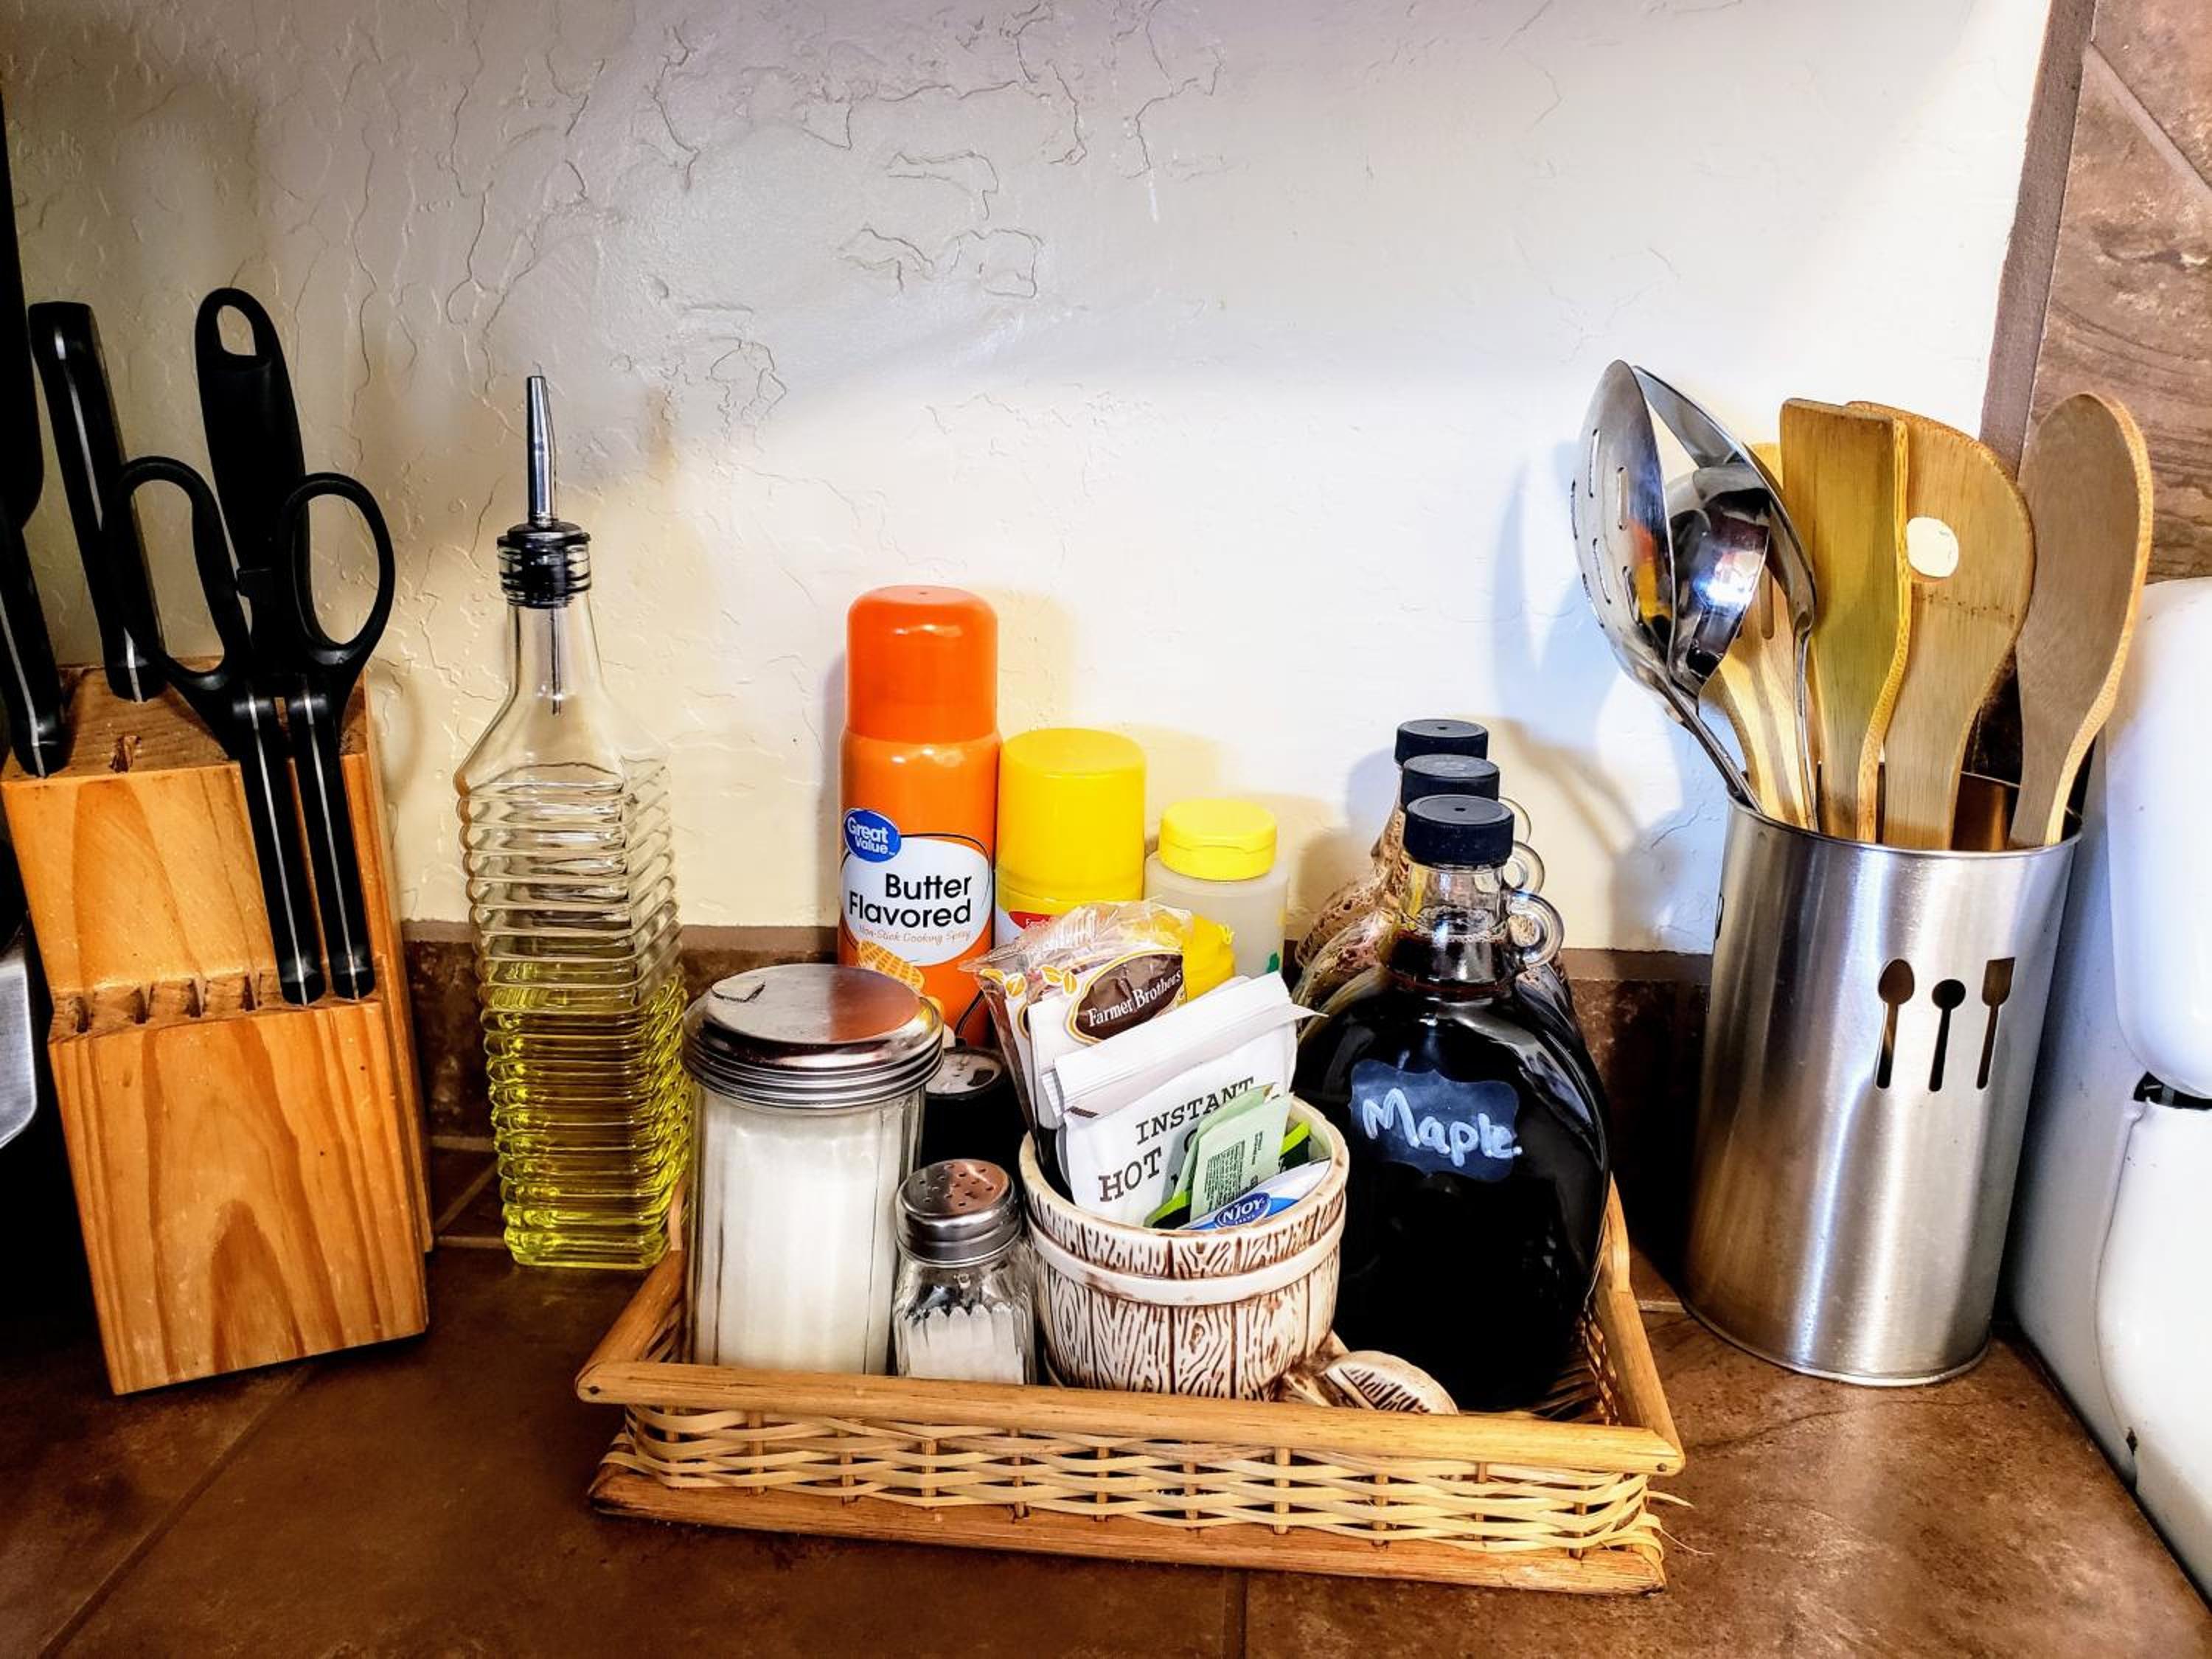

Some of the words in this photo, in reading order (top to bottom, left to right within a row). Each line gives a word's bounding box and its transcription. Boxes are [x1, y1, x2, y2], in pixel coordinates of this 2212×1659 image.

[847, 816, 888, 844] Great
[855, 835, 888, 855] Value
[886, 873, 972, 900] Butter
[849, 890, 971, 928] Flavored
[903, 932, 944, 945] Cooking
[1087, 1000, 1135, 1027] Farmer
[1132, 970, 1181, 1009] Brothers
[1135, 1076, 1254, 1145] INSTANT
[1362, 1087, 1523, 1167] Maple
[1098, 1146, 1163, 1203] HOT
